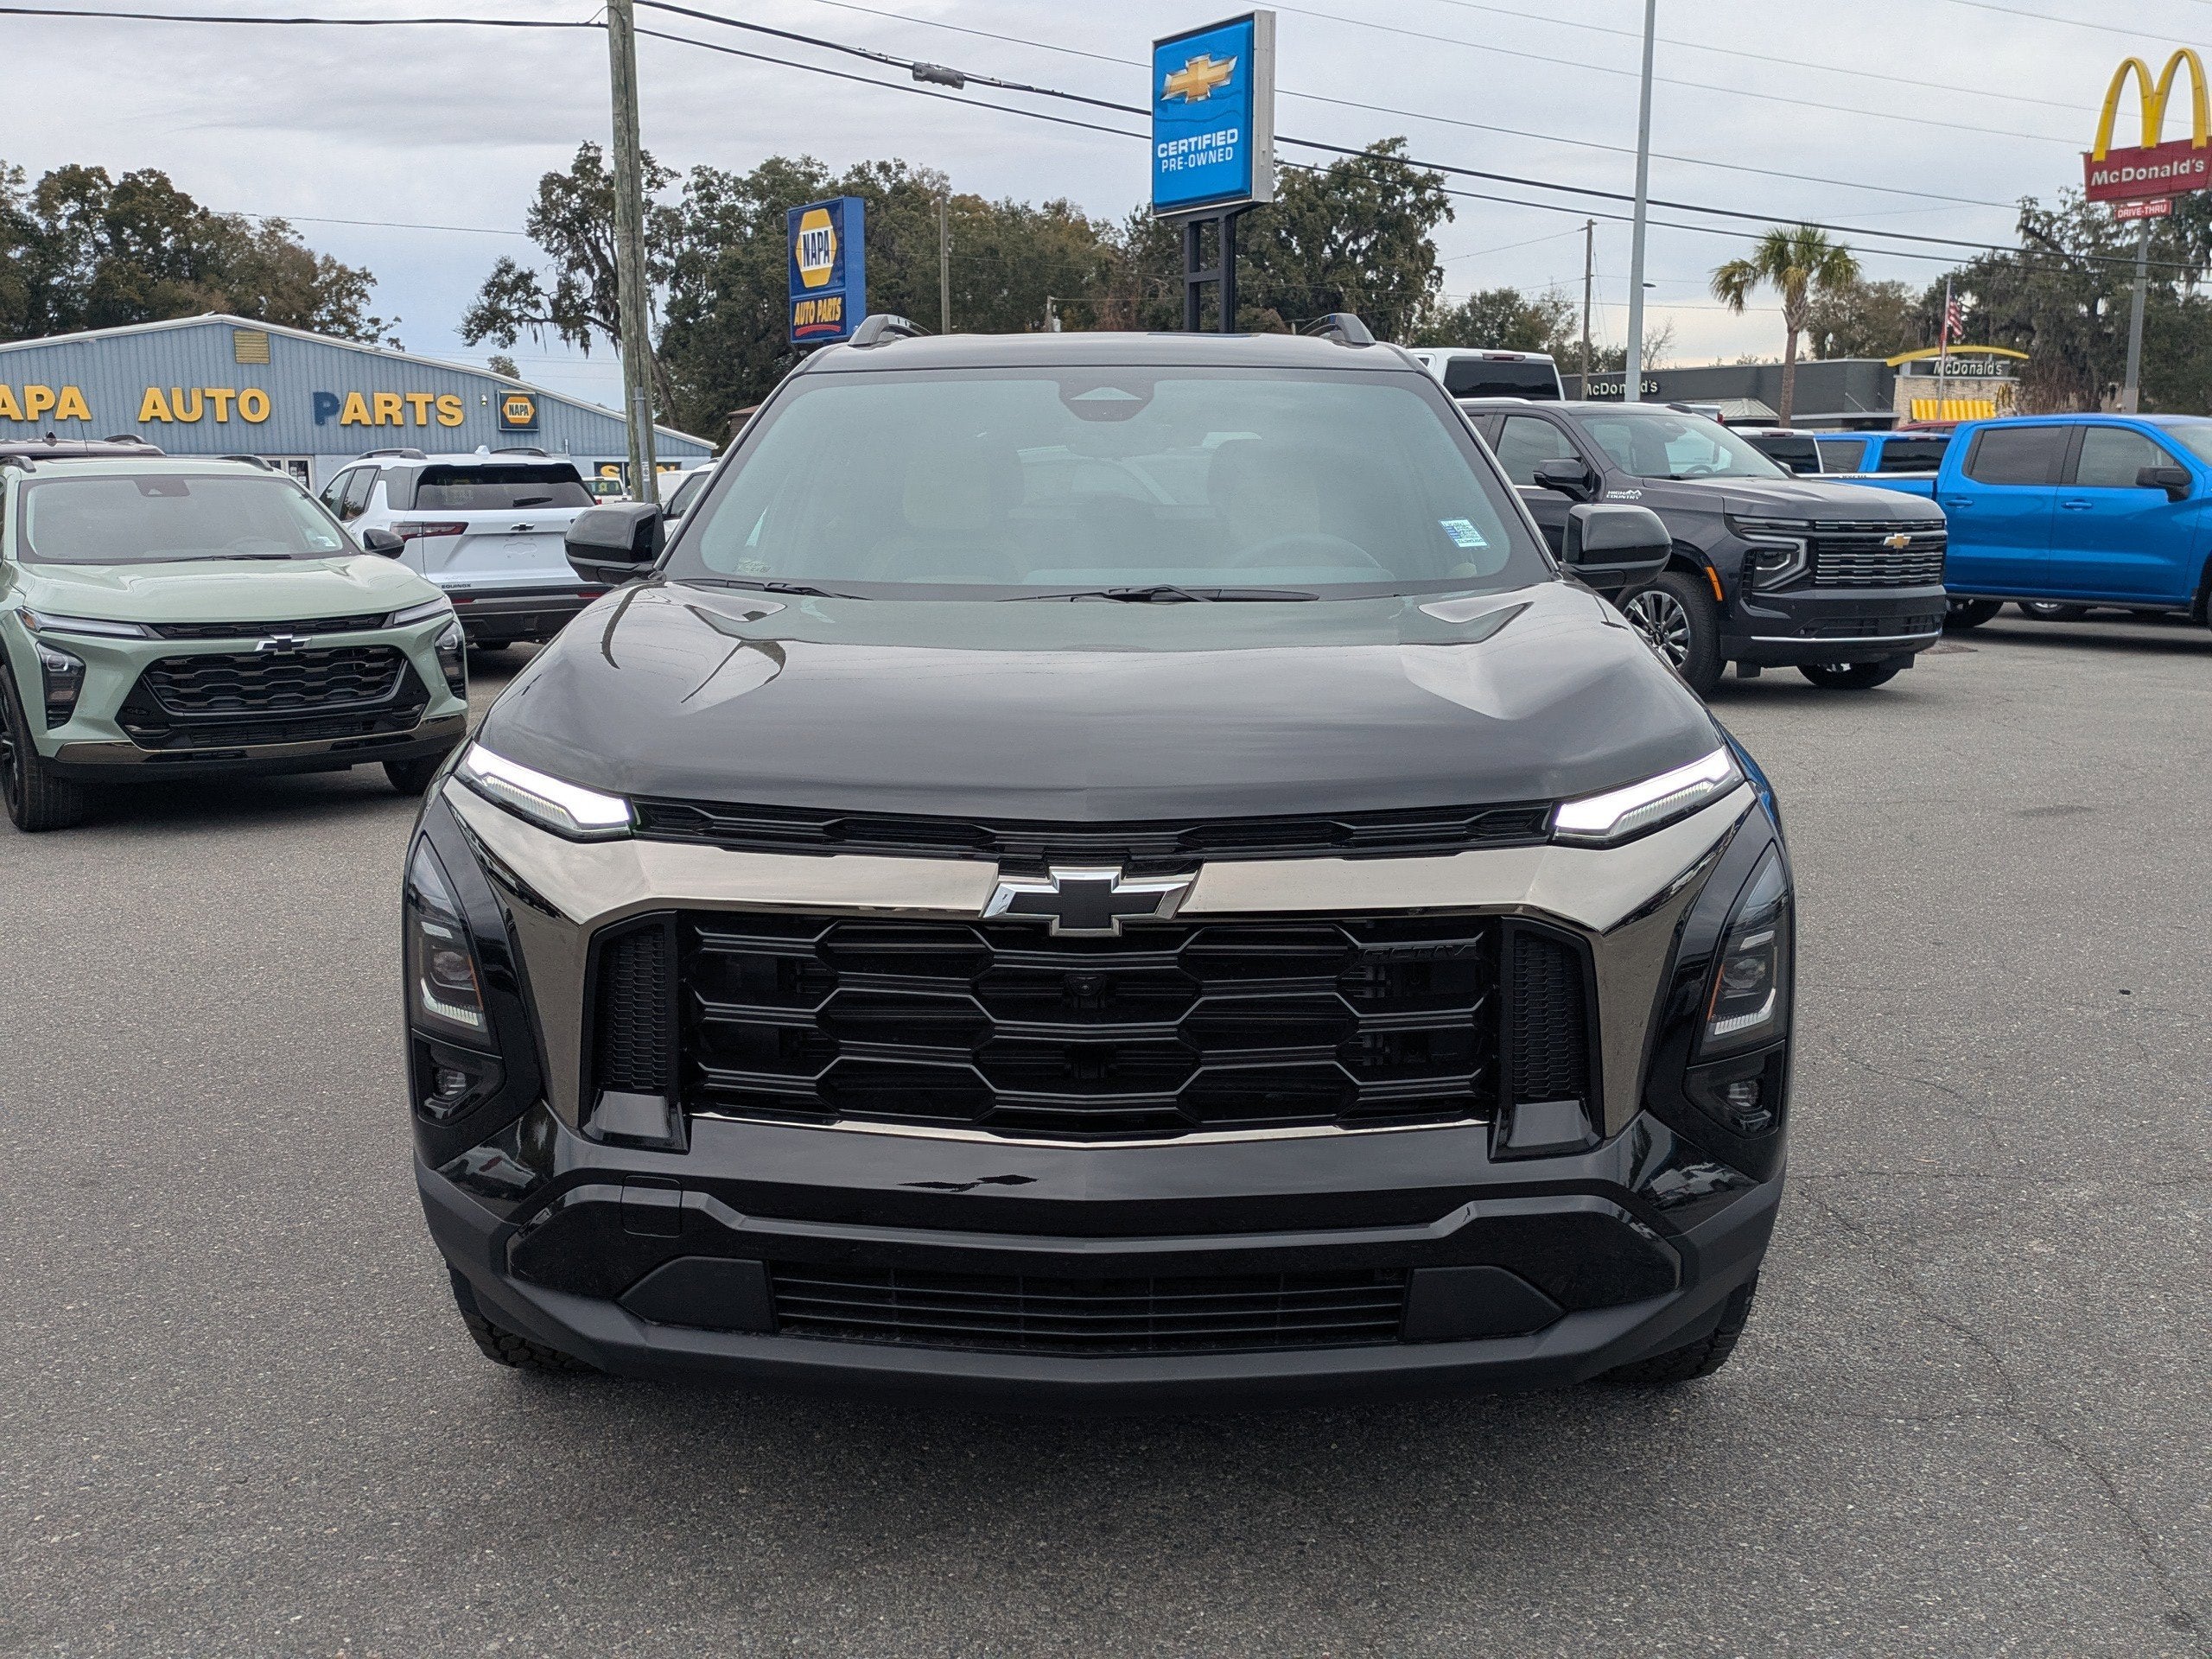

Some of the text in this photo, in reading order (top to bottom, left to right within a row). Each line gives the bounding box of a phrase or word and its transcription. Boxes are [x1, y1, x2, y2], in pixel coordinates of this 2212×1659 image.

[1158, 128, 1238, 158] CERTIFIED
[1161, 146, 1233, 173] PRE-OWNED
[2091, 158, 2205, 187] McDonald's
[2117, 204, 2167, 219] DRIVE-THRU
[803, 230, 830, 267] NAPA
[793, 297, 842, 326] AUTO PARTS
[1586, 380, 1658, 396] cDond's
[138, 387, 270, 423] AUTO
[313, 391, 464, 427] PARTS
[508, 404, 530, 416] NAPA
